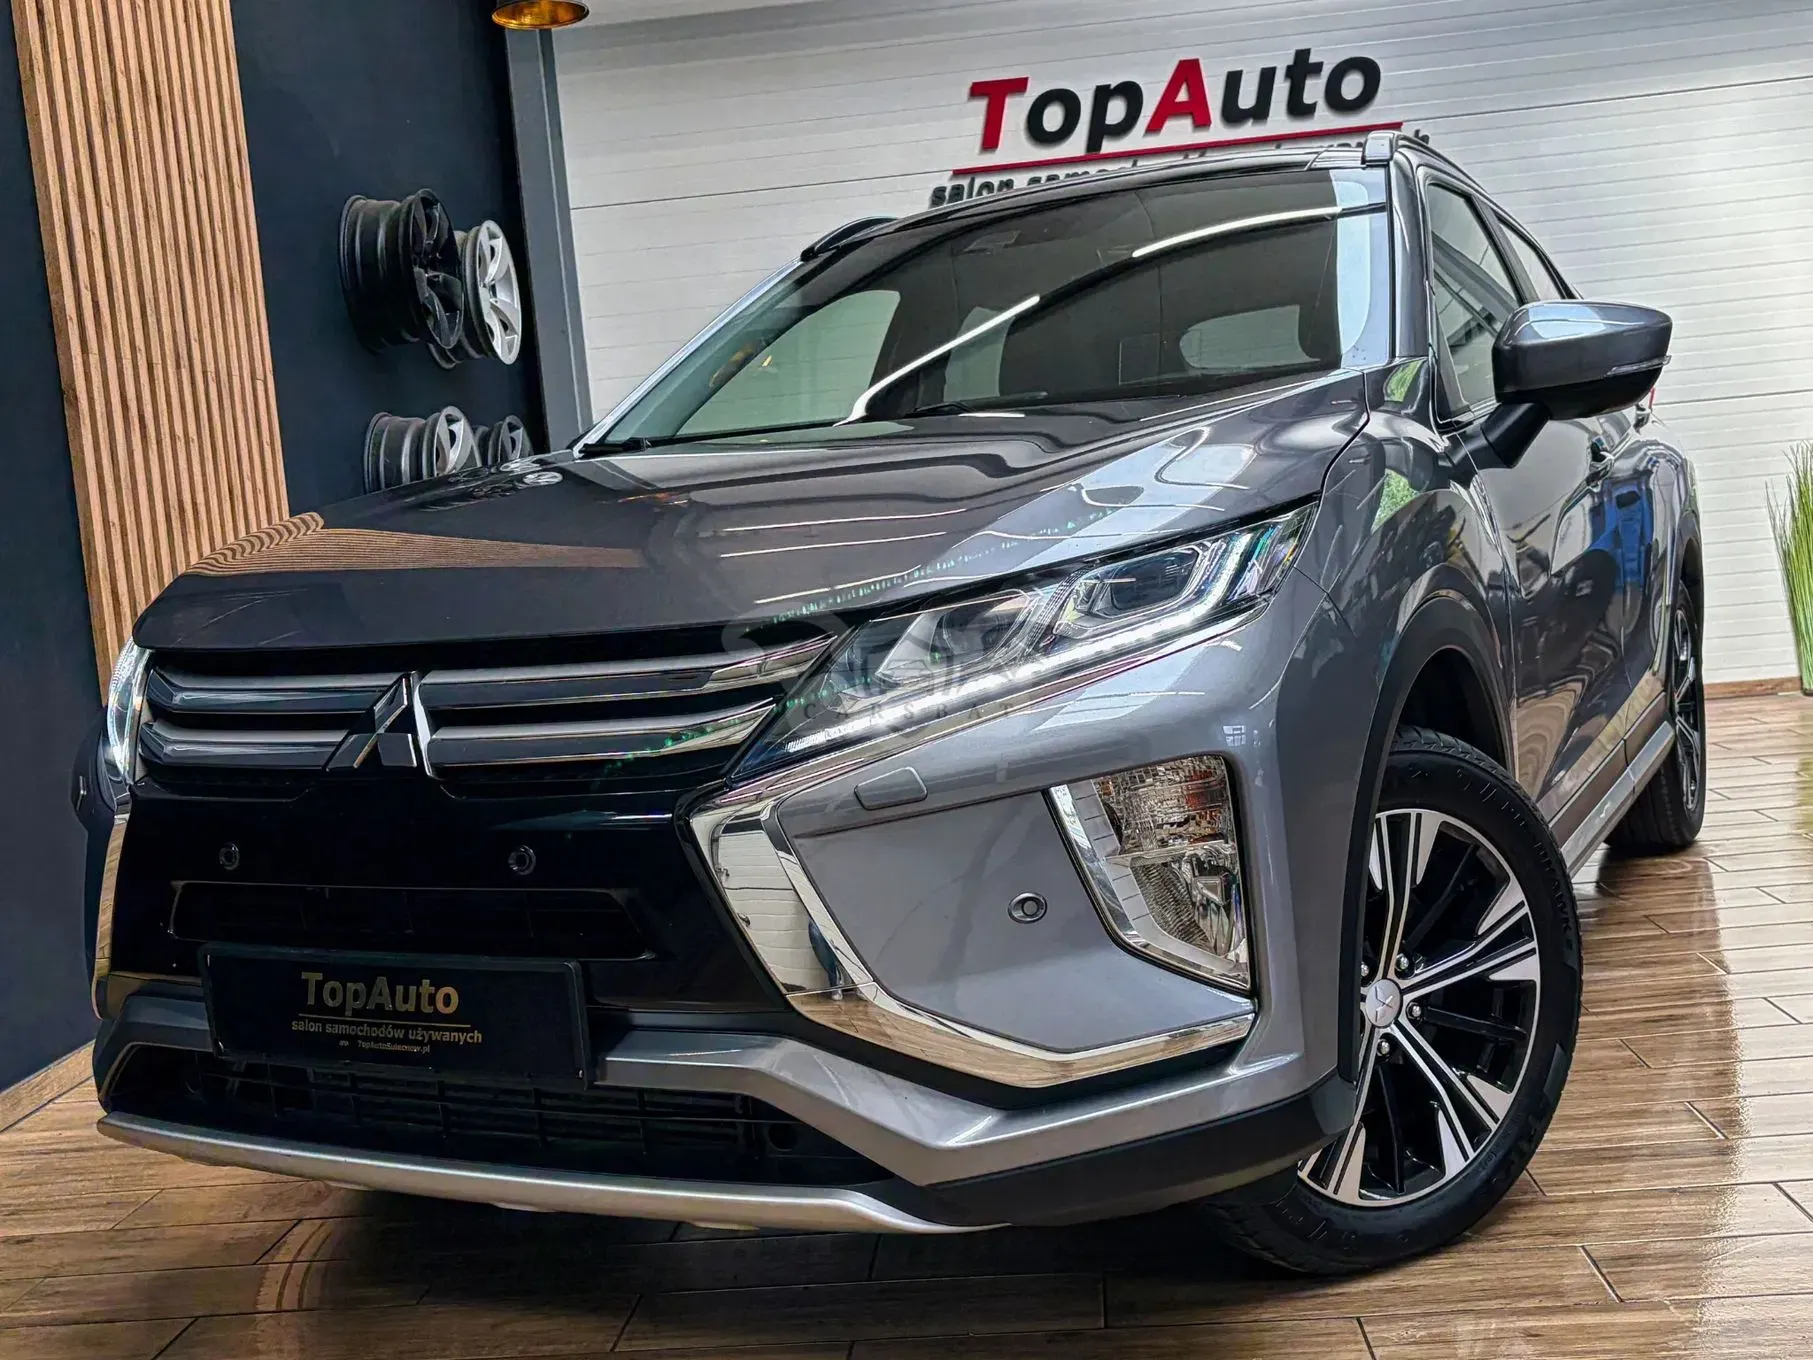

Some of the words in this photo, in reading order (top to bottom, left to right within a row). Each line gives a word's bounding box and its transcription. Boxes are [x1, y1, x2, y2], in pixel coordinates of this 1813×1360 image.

[969, 48, 1381, 153] TopAuto
[301, 971, 460, 1016] TopAuto
[291, 1018, 323, 1033] salon
[325, 1021, 405, 1039] samochodów
[408, 1026, 483, 1045] używanych
